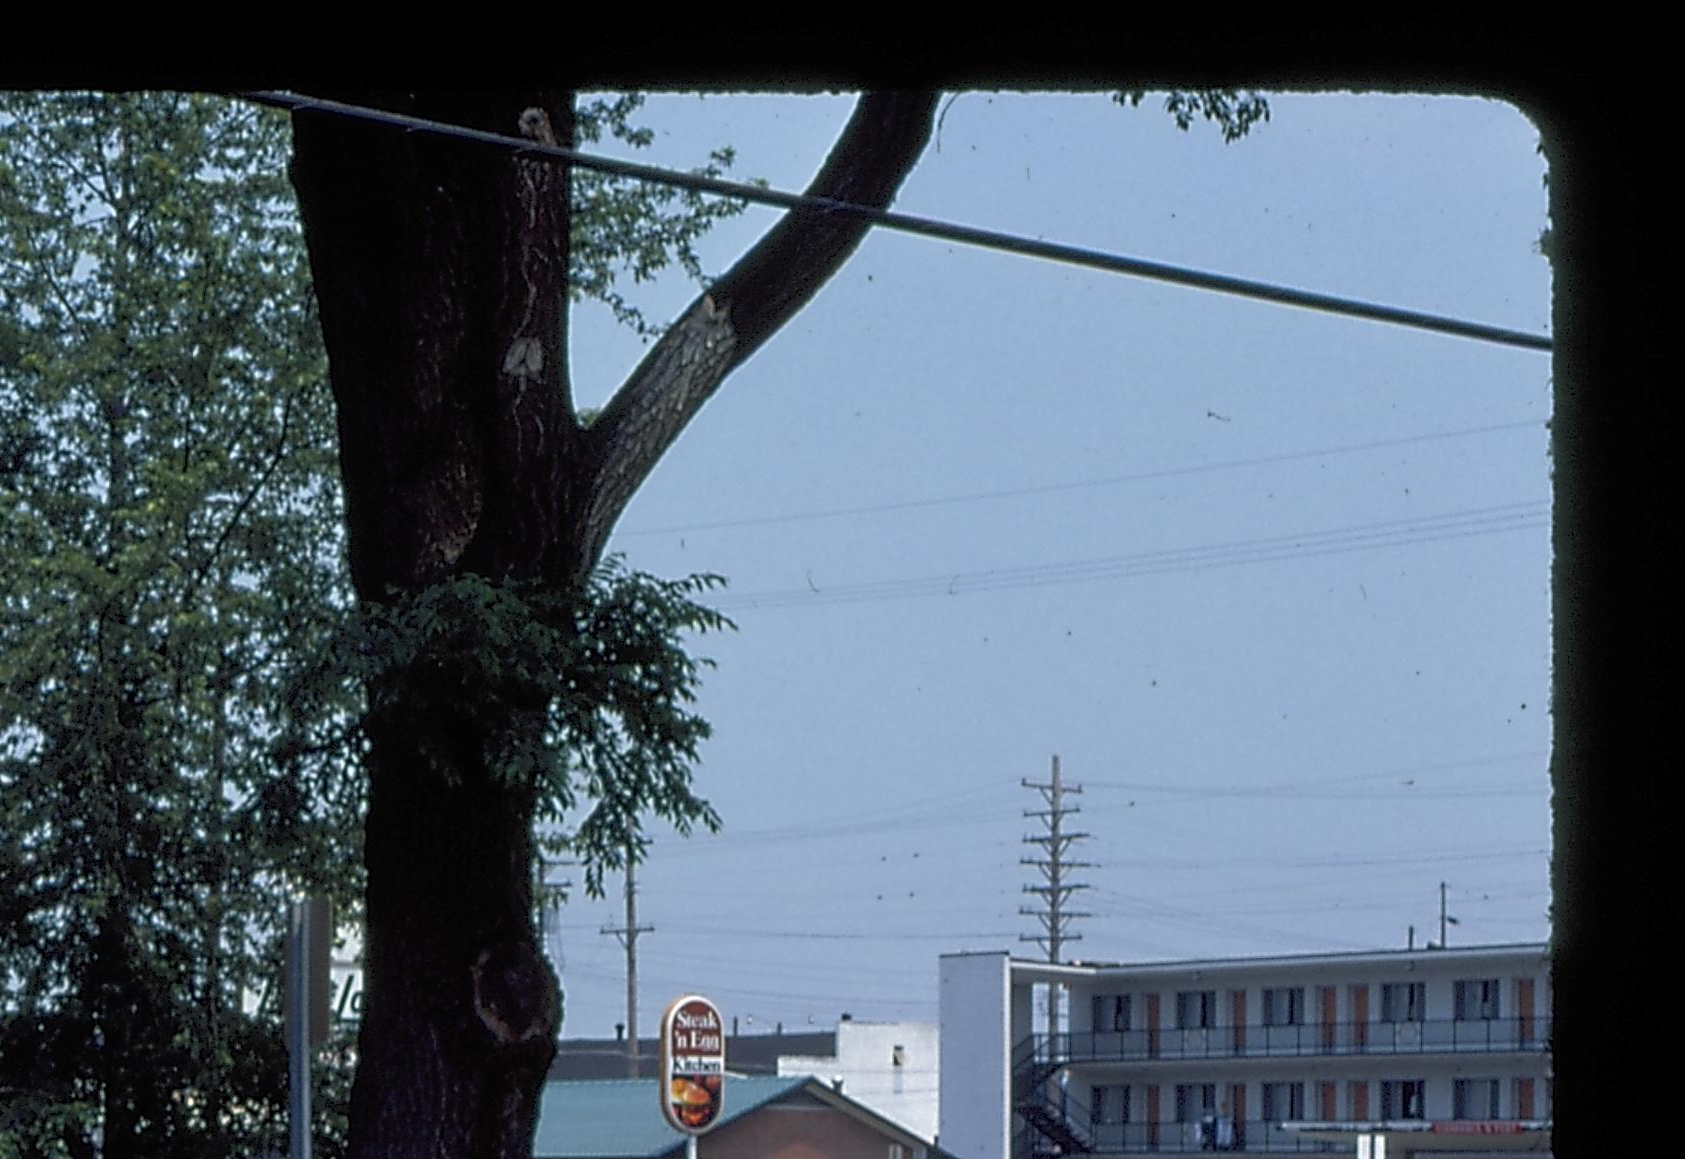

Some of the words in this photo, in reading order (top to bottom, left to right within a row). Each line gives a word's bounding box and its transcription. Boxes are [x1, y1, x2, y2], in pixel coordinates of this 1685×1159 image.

[676, 1010, 718, 1028] Steak
[674, 1030, 687, 1048] 'n
[690, 1031, 719, 1052] Egg
[673, 1056, 721, 1071] Kitchen
